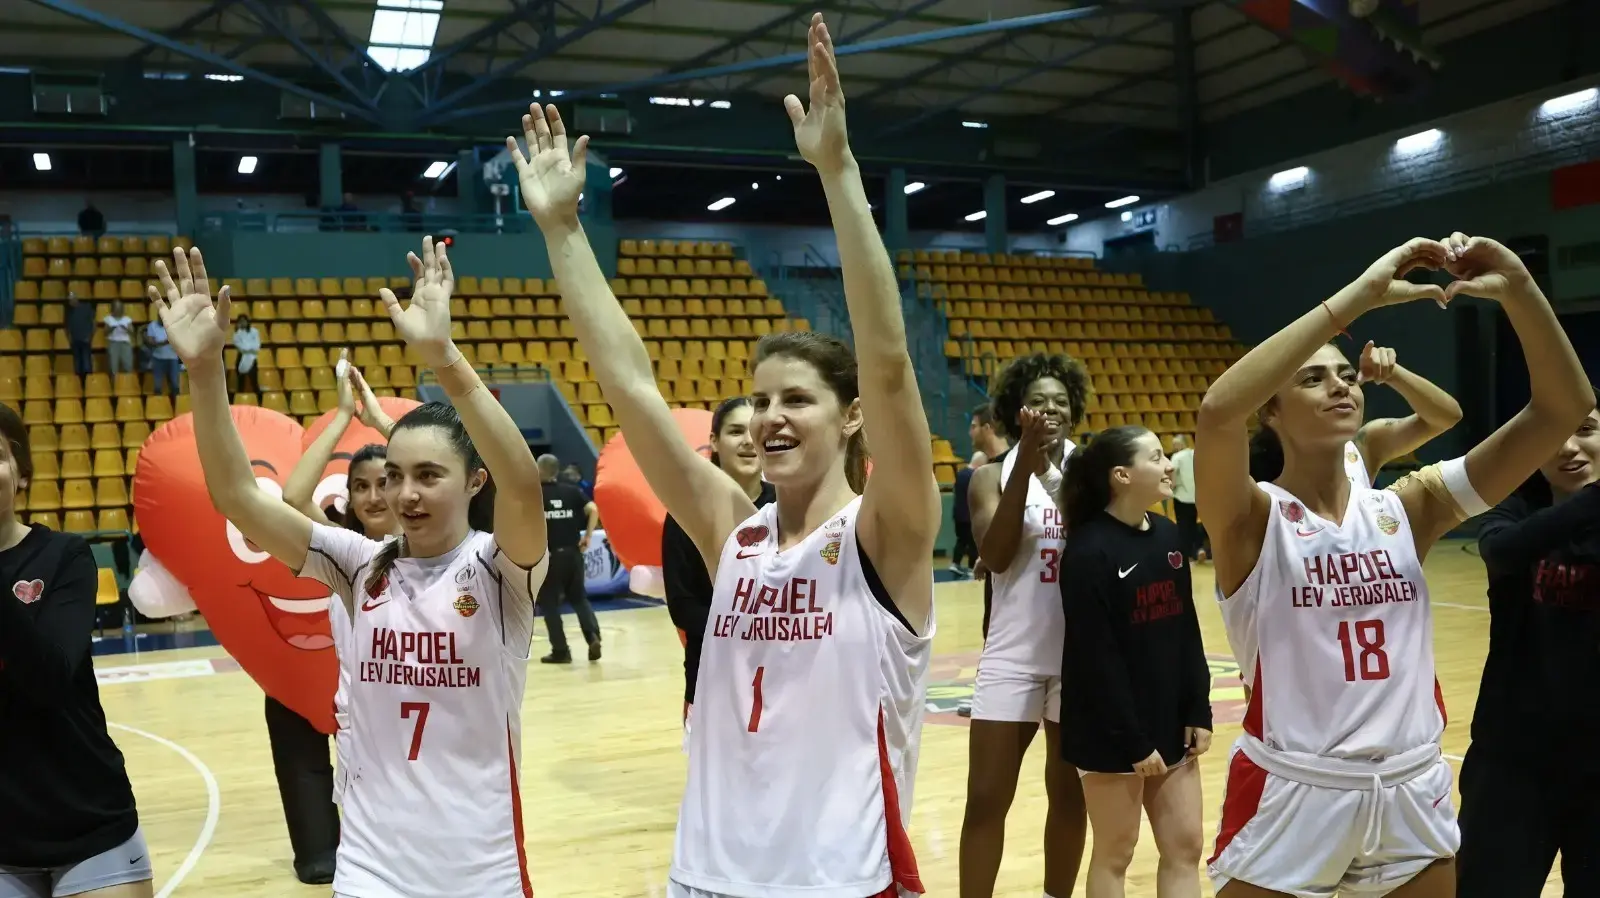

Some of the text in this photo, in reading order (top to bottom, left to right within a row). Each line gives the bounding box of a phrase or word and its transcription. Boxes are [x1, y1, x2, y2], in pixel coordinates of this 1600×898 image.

[1303, 549, 1404, 585] HAPOEL
[731, 577, 824, 614] HPOEL
[1291, 581, 1419, 608] LEV JERUSALEM
[713, 611, 833, 642] LEV JRUSALEM
[371, 627, 464, 665] HAPOEL
[1337, 619, 1391, 682] 18
[360, 661, 481, 688] LEV JERUSALEM
[747, 666, 765, 733] 1
[400, 702, 430, 761] 7
